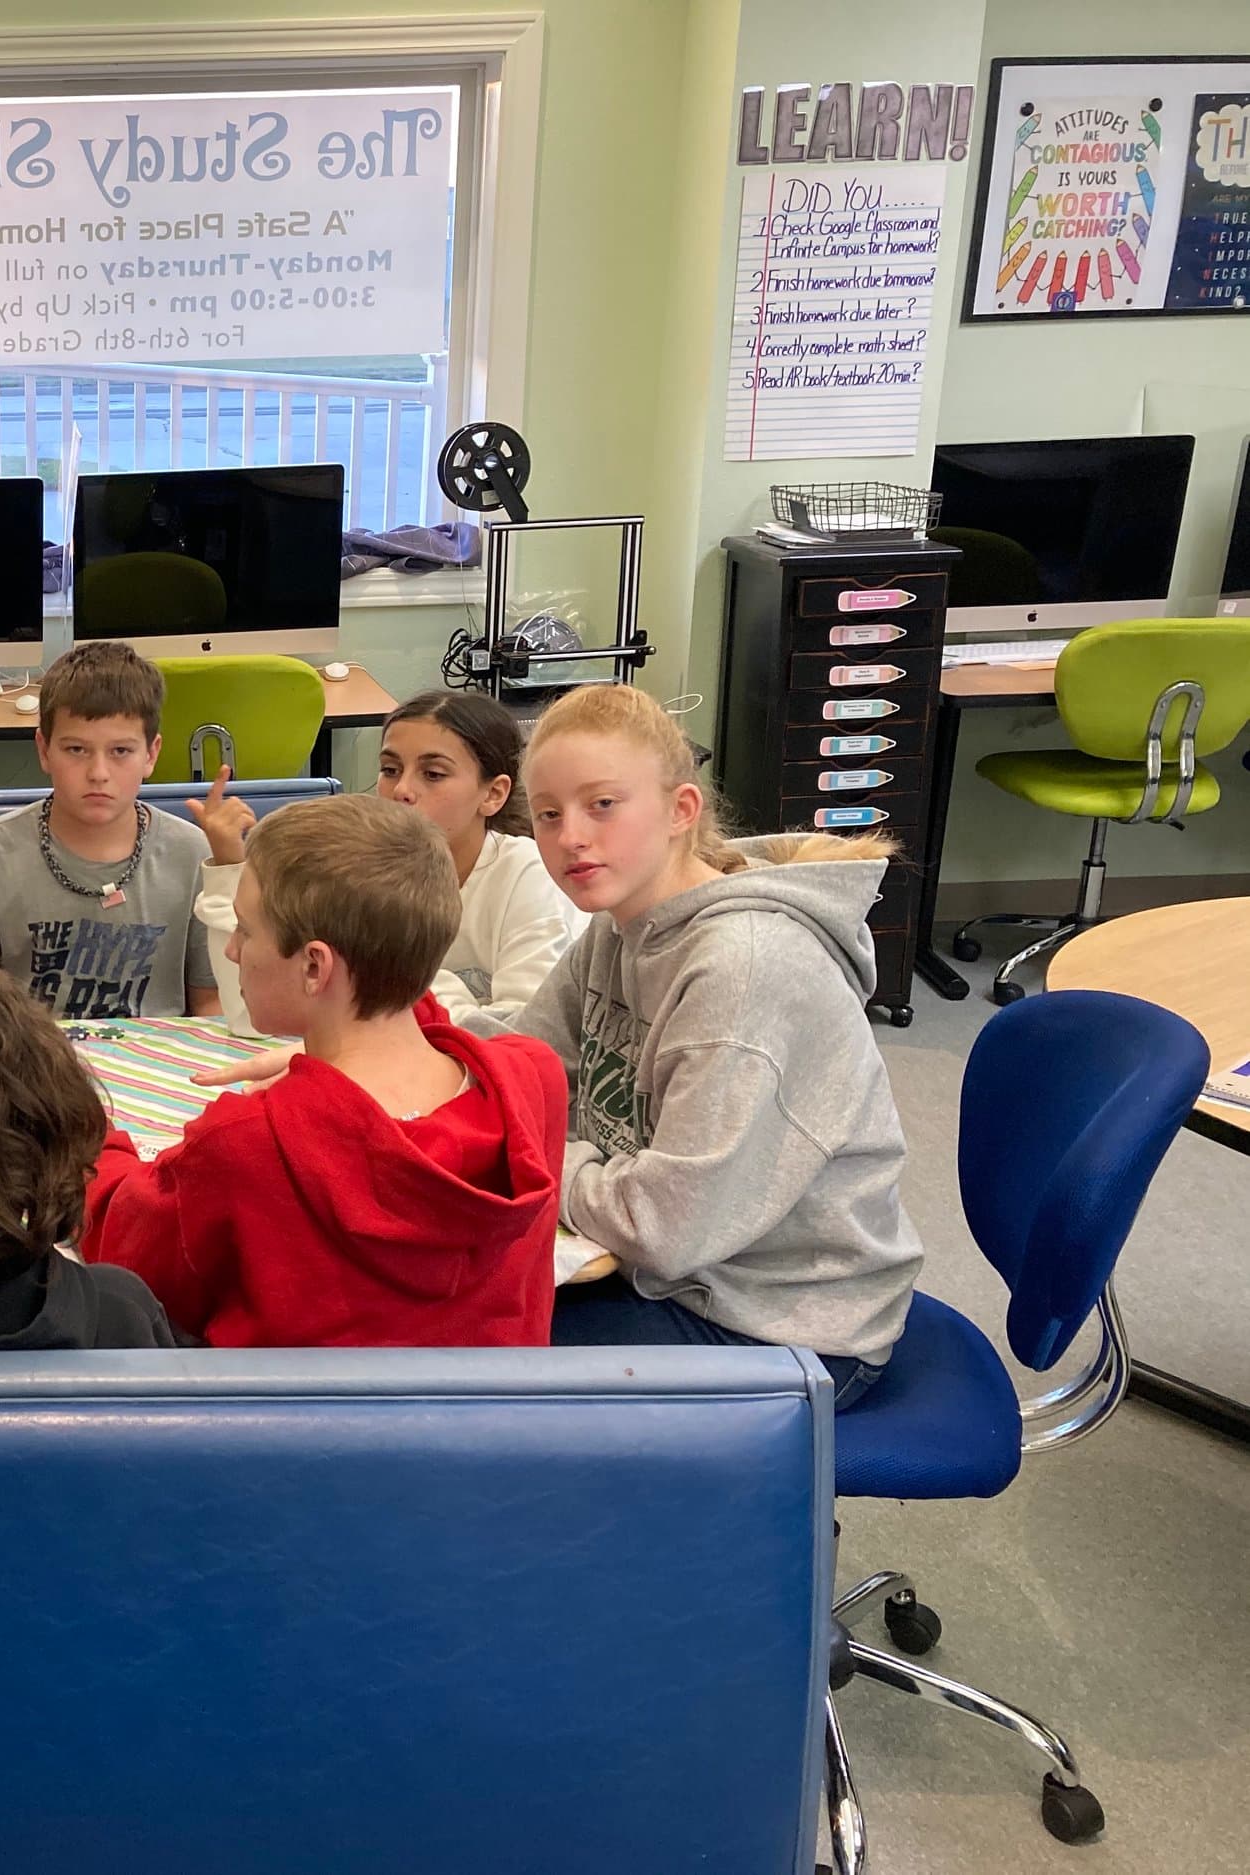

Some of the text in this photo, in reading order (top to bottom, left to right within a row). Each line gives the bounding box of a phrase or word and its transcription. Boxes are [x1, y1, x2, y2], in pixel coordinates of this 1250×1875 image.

[737, 81, 976, 165] LEARN!
[1054, 109, 1129, 137] ATTITUDES
[1083, 130, 1100, 142] ARE
[1057, 170, 1118, 188] IS YOURS
[781, 177, 832, 213] DID
[1037, 191, 1132, 218] WORTH
[770, 212, 814, 237] Check
[819, 210, 862, 240] Google
[865, 210, 919, 236] Classroom
[920, 207, 941, 231] and
[1031, 218, 1128, 240] CATCHING?
[1213, 211, 1249, 225] TRUE
[768, 236, 820, 259] Infinite
[823, 235, 866, 259] Campus
[868, 232, 884, 255] for
[766, 267, 805, 293] Finish
[806, 265, 861, 291] homework
[862, 265, 882, 288] due
[764, 302, 795, 325] Finish
[796, 299, 848, 324] homework
[849, 298, 872, 322] due
[875, 298, 903, 320] later
[759, 334, 808, 362] Correctly
[809, 332, 854, 358] complete
[858, 330, 886, 353] math
[889, 329, 927, 352] sheet?
[757, 366, 784, 389] Read
[785, 365, 802, 388] AR
[28, 919, 73, 950] THE
